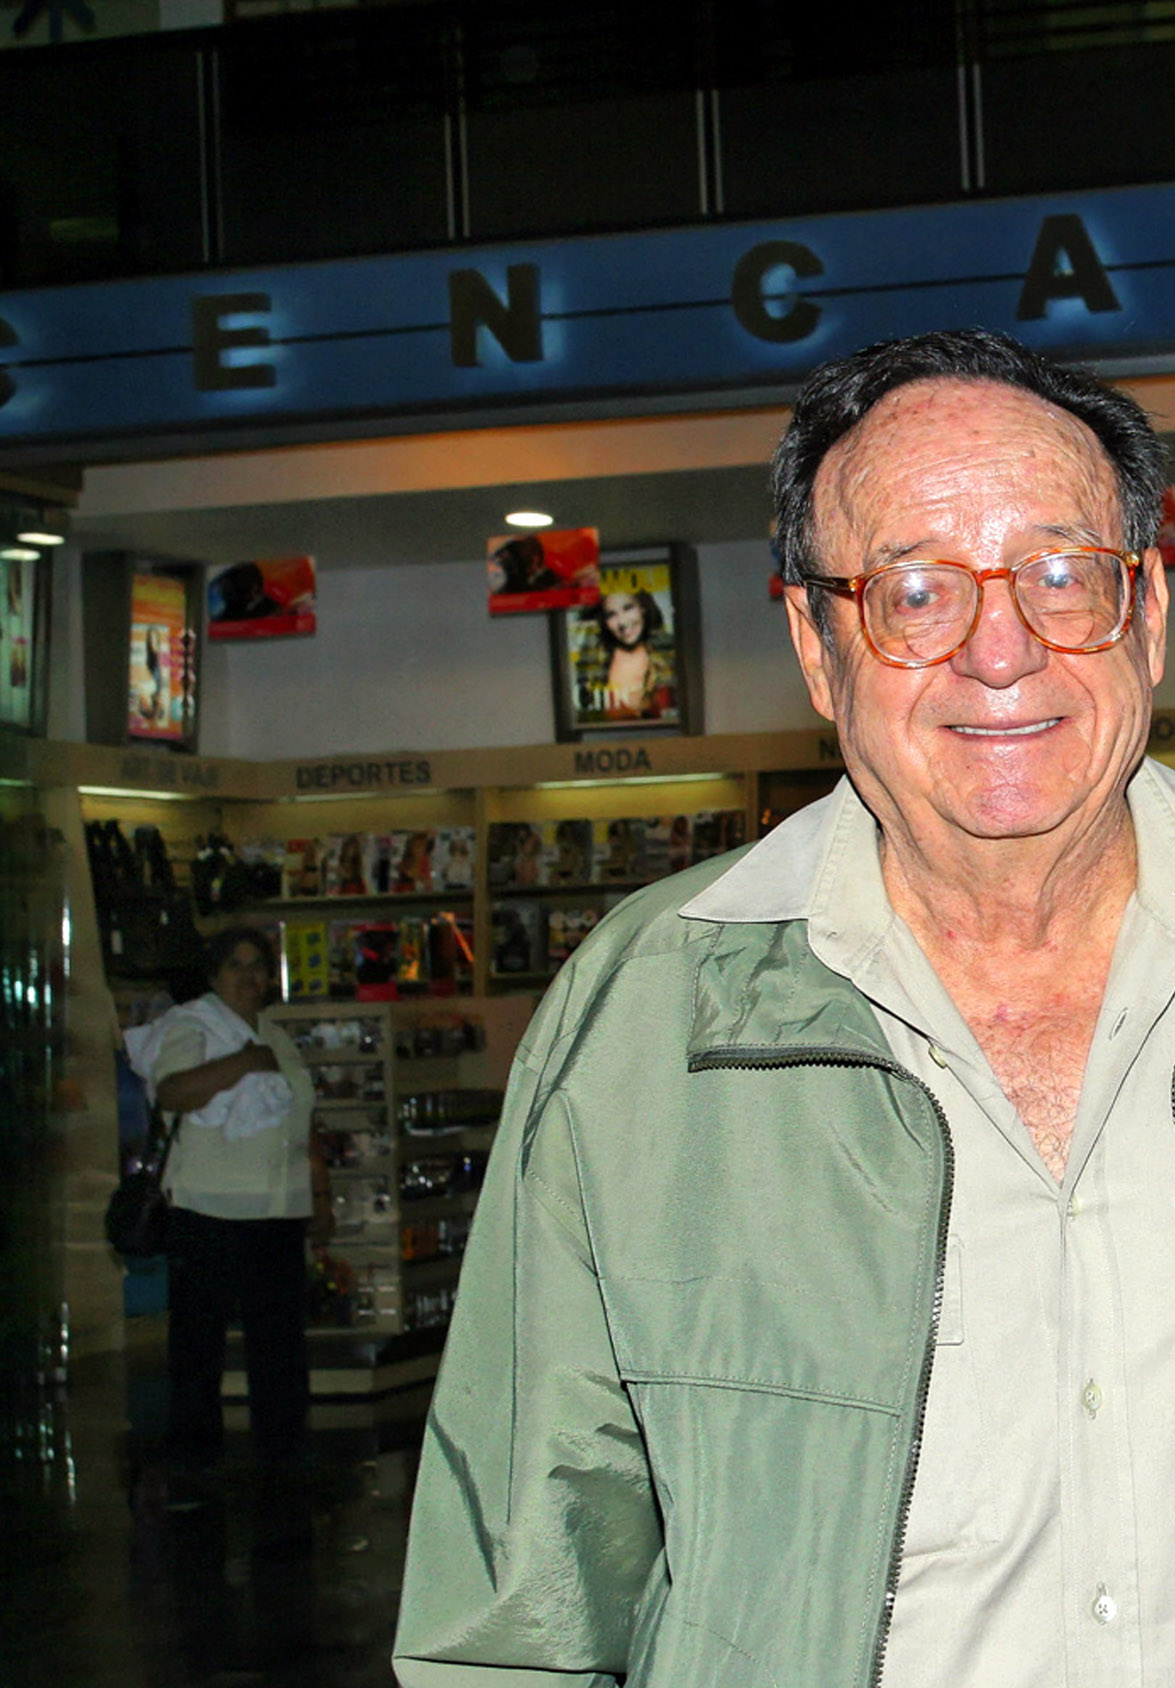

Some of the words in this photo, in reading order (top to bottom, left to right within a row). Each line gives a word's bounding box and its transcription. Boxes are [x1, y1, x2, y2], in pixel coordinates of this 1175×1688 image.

[0, 213, 1122, 411] ENCA
[296, 760, 432, 789] DEPORTES
[574, 748, 652, 773] MODA
